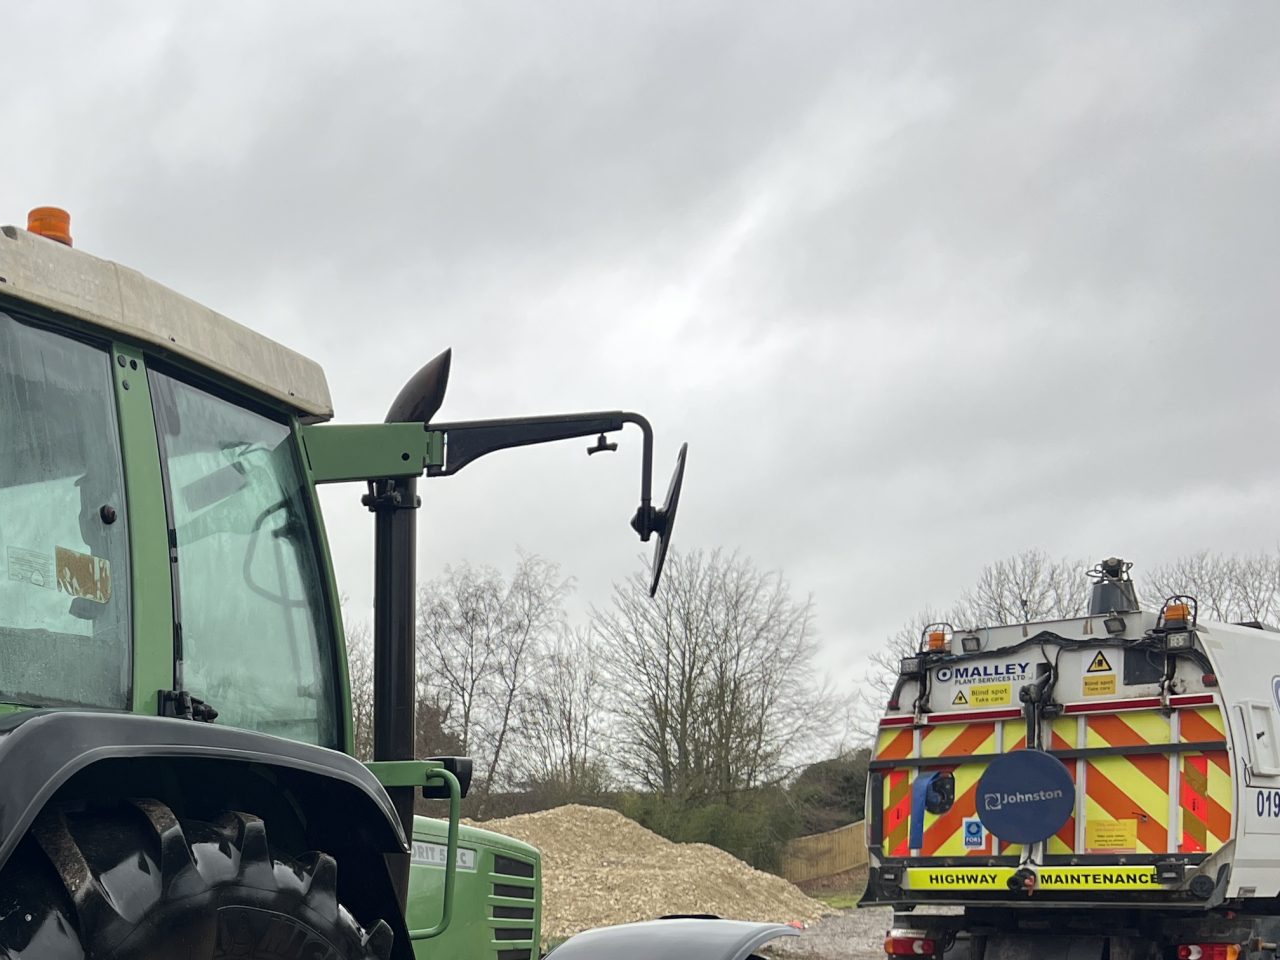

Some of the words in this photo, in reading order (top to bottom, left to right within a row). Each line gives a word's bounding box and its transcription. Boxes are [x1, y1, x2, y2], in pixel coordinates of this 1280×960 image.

[954, 678, 976, 686] PLANT
[978, 675, 1011, 684] SERVICES
[1002, 789, 1063, 804] Johnston
[929, 874, 998, 884] HIGHWAY
[1040, 873, 1158, 885] MAINTENANCE
